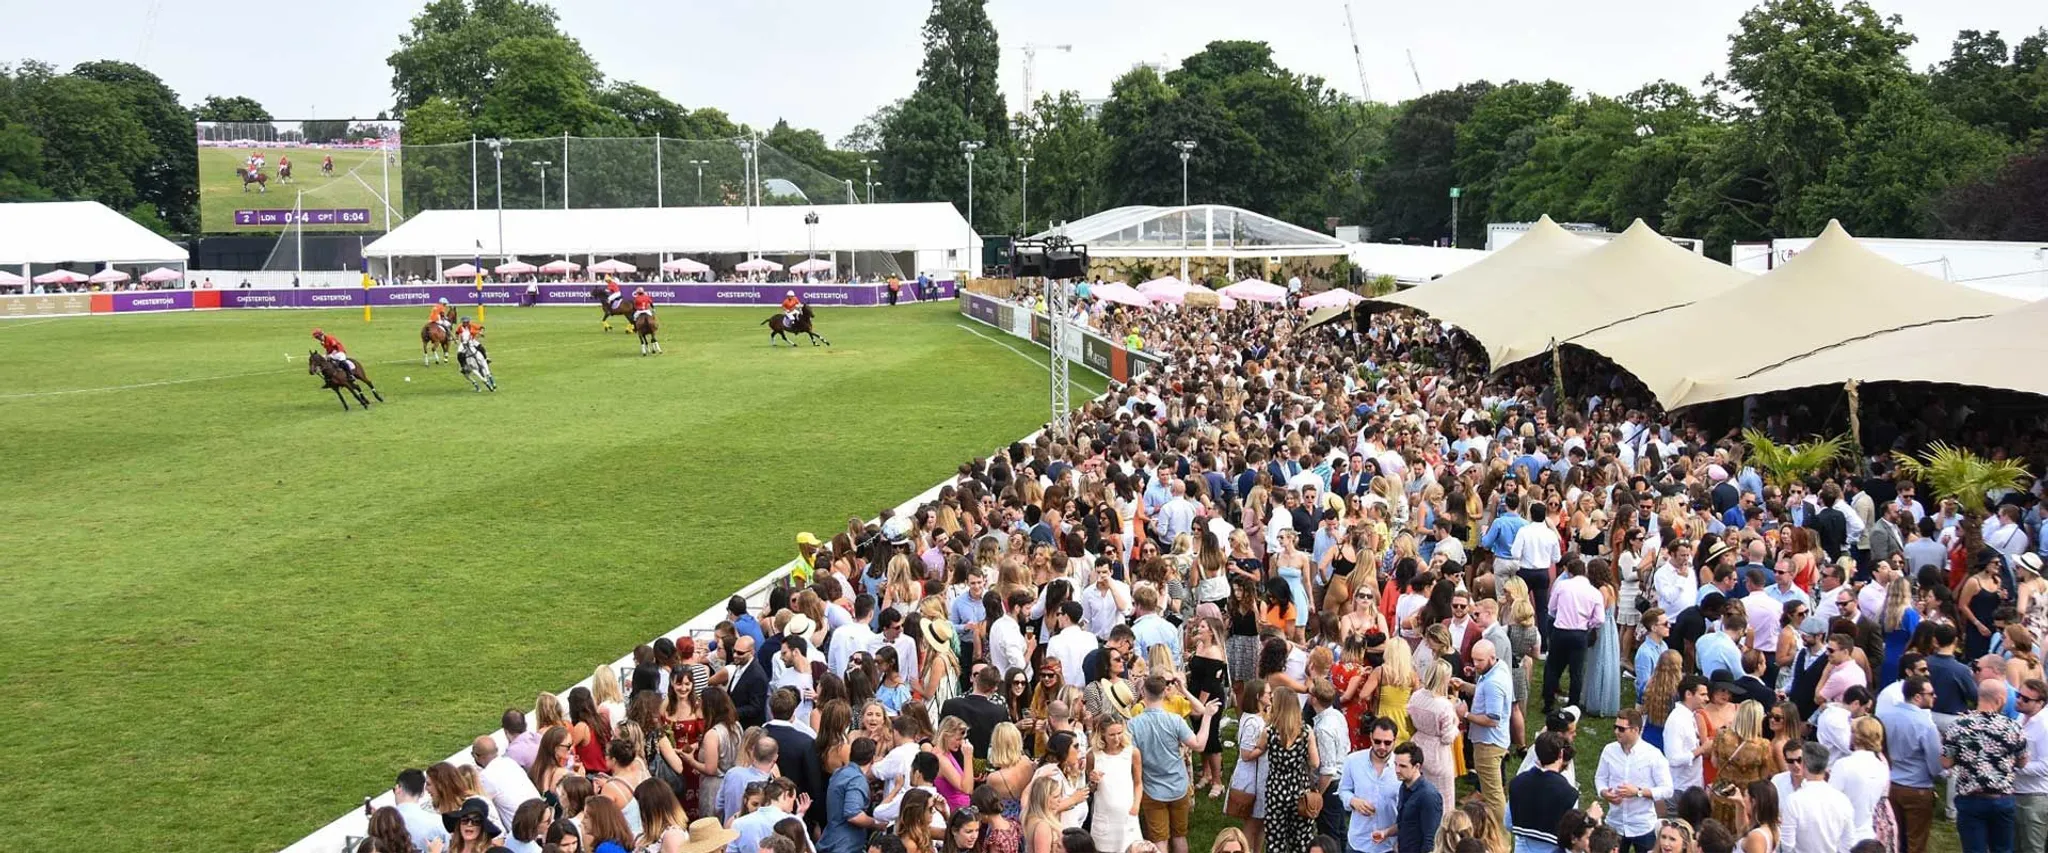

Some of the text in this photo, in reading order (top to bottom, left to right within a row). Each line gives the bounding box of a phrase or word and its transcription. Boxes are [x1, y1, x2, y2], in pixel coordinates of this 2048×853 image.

[243, 214, 250, 223] 2
[317, 213, 333, 221] CPT
[343, 212, 364, 221] 6:04
[132, 298, 174, 306] CHESTERTONS
[312, 294, 352, 302] CHESTERTONS
